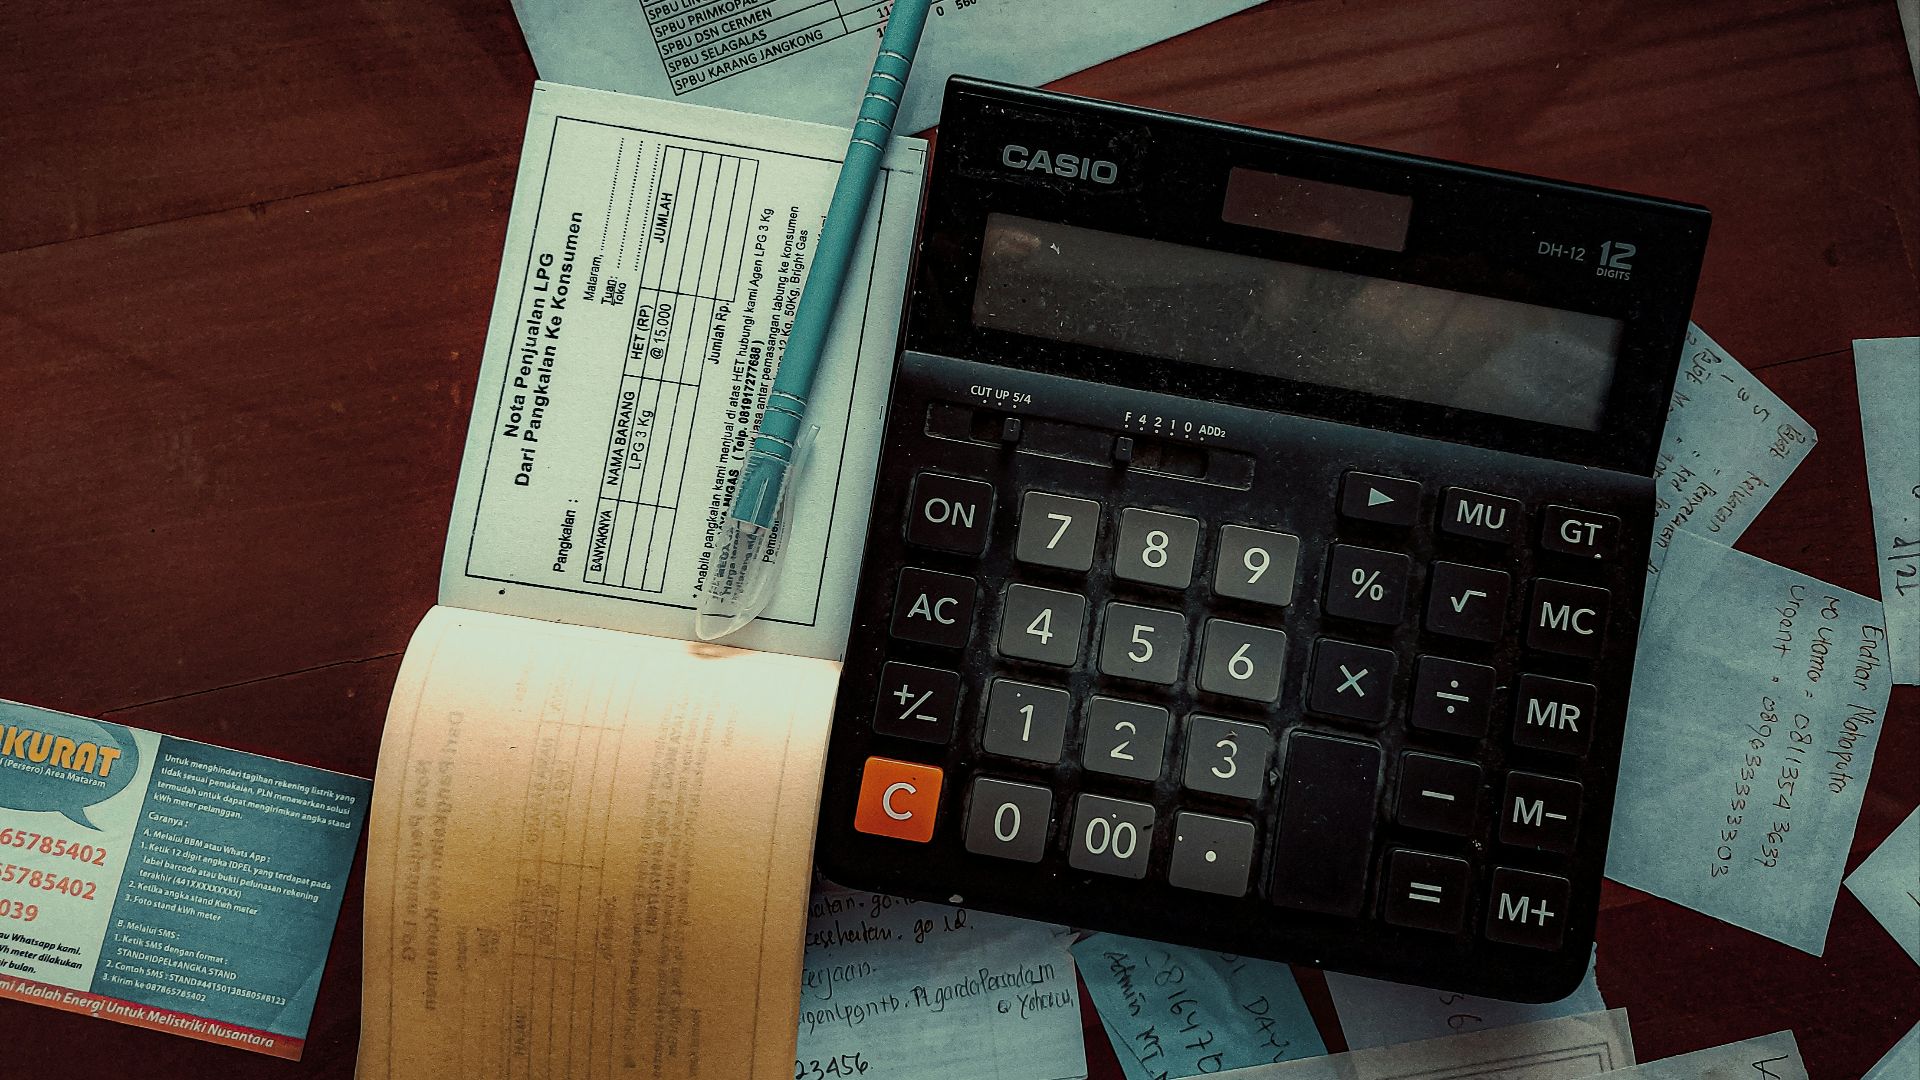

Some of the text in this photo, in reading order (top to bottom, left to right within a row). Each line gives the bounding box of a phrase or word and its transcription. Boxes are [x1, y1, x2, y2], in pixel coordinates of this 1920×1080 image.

[648, 0, 679, 20] SPBU
[654, 18, 686, 38] SPBU
[661, 7, 772, 56] SPBU DSN CERMEN
[668, 29, 767, 73] SPBU SELAGALAS
[674, 29, 823, 91] SPBU KARANG JANGKONG
[1002, 144, 1118, 184] CASIO
[789, 229, 808, 284] Bright Gas
[1537, 241, 1585, 261] DH-12
[1597, 240, 1636, 270] 12
[1596, 266, 1631, 281] DIGITS
[761, 206, 799, 381] pemasangan tabung ke konsumen
[502, 253, 553, 437] Nota Penjualan LPG
[514, 212, 583, 486] Dari Pangkalan Ke Konsumen
[707, 305, 731, 365] Jumlah Rp.
[590, 192, 672, 572] BANYAKNYA NAMA BARANG HET (RP) JUMLAH
[628, 303, 672, 470] LPG 3 Kg @ 15.000
[703, 234, 767, 549] pangkalan kami menjual di atas HET hubungi kami Agen LPG
[970, 385, 1031, 404] CUT UP 5/4
[732, 427, 749, 453] Telp.
[924, 497, 975, 528] ON
[1456, 496, 1507, 529] MU
[552, 509, 576, 573] Pangkalan
[1046, 512, 1072, 549] 7
[1560, 519, 1603, 546] GT
[1142, 530, 1169, 567] 8
[1243, 547, 1270, 584] 9
[906, 593, 958, 624] AC
[1539, 601, 1596, 635] MC
[1026, 608, 1053, 644] 4
[1127, 624, 1154, 662] 5
[1228, 643, 1254, 680] 6
[1019, 704, 1033, 741] 1
[1526, 698, 1580, 732] MR
[1110, 721, 1136, 761] 2
[3, 758, 106, 788] (Persero) Area Mataram
[1211, 739, 1237, 778] 3
[161, 767, 350, 815] tidak sesuai PLN menawarkan solusi
[164, 754, 189, 766] Untuk
[190, 761, 242, 778] menghindari
[242, 772, 273, 785] tagihan
[274, 780, 310, 795] rekening
[334, 793, 355, 804] yang
[153, 792, 172, 803] kWh
[172, 798, 197, 808] meter
[157, 780, 351, 829] termudah untuk dapat angka stand
[882, 782, 916, 820] C
[148, 811, 183, 826] Caranya
[994, 802, 1020, 841] 0
[153, 830, 266, 863] Melalui BBM atau Whats App
[1085, 815, 1137, 858] 00
[139, 869, 172, 882] terakhir
[197, 869, 319, 903] atau bukti rekening
[202, 856, 331, 890] angka yang terdapat pada
[153, 901, 221, 921] stand meter
[163, 889, 214, 905] angka stand
[1498, 892, 1554, 926] M+
[11, 933, 56, 951] Whatsapp
[157, 928, 176, 939] SMS
[8, 960, 36, 974] bulan.
[9, 948, 83, 969] meter dilakukan
[144, 940, 224, 963] SMS dengan format
[111, 974, 133, 986] Kirim
[114, 961, 164, 979] Contoh SMS
[208, 967, 237, 980] STAND
[14, 982, 274, 1047] Adalah Energi Untuk Melistriki Nusantara
